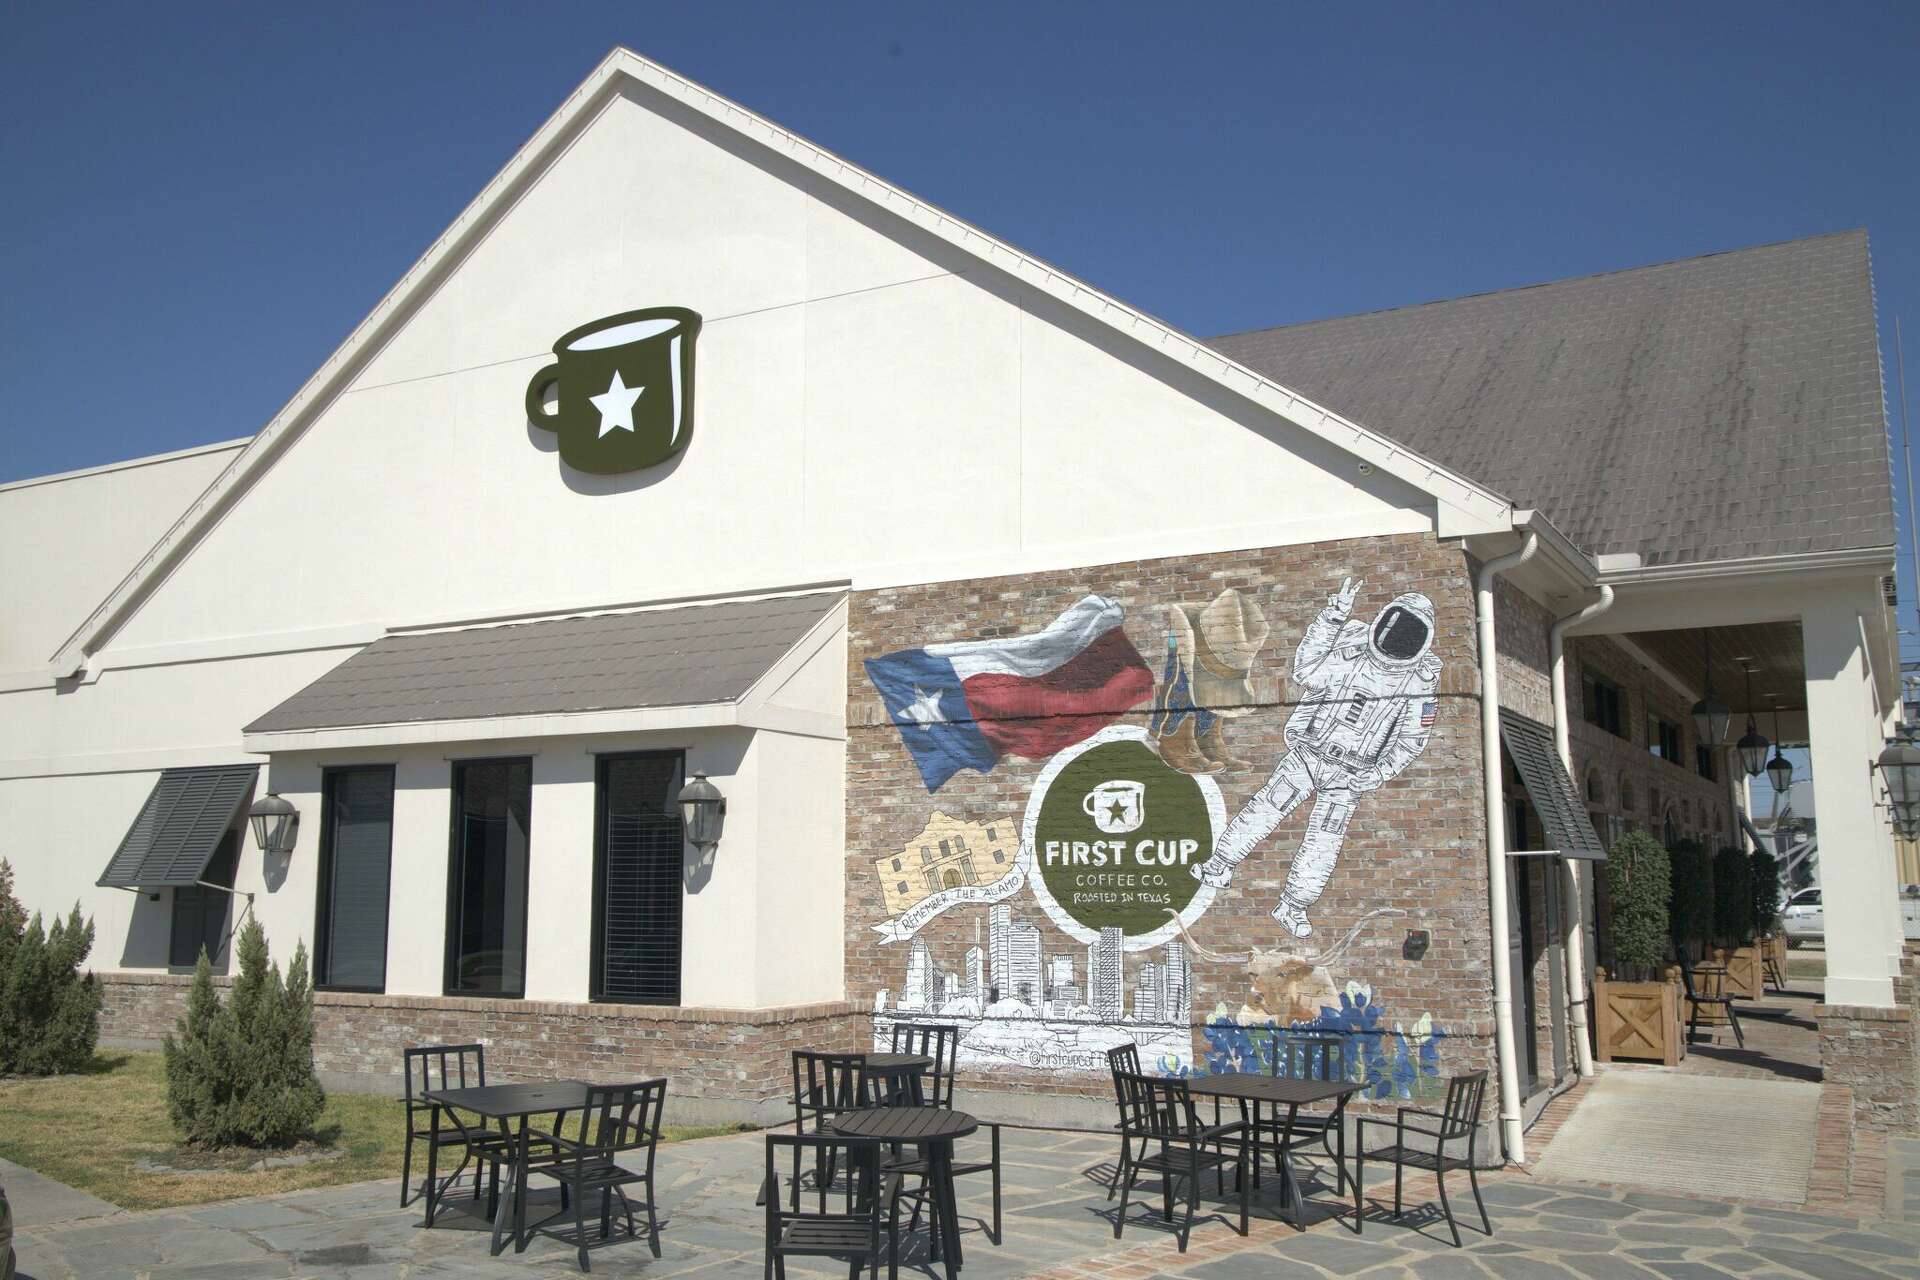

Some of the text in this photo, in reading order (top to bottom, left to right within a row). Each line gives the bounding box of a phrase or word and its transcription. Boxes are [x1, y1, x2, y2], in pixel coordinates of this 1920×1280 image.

[1045, 839, 1199, 866] FIRST CUP
[1076, 874, 1168, 887] COFFEE CO.
[902, 876, 1019, 931] REMEMBER THE ALAMO
[1073, 892, 1171, 905] ROASTED IN TEXAS
